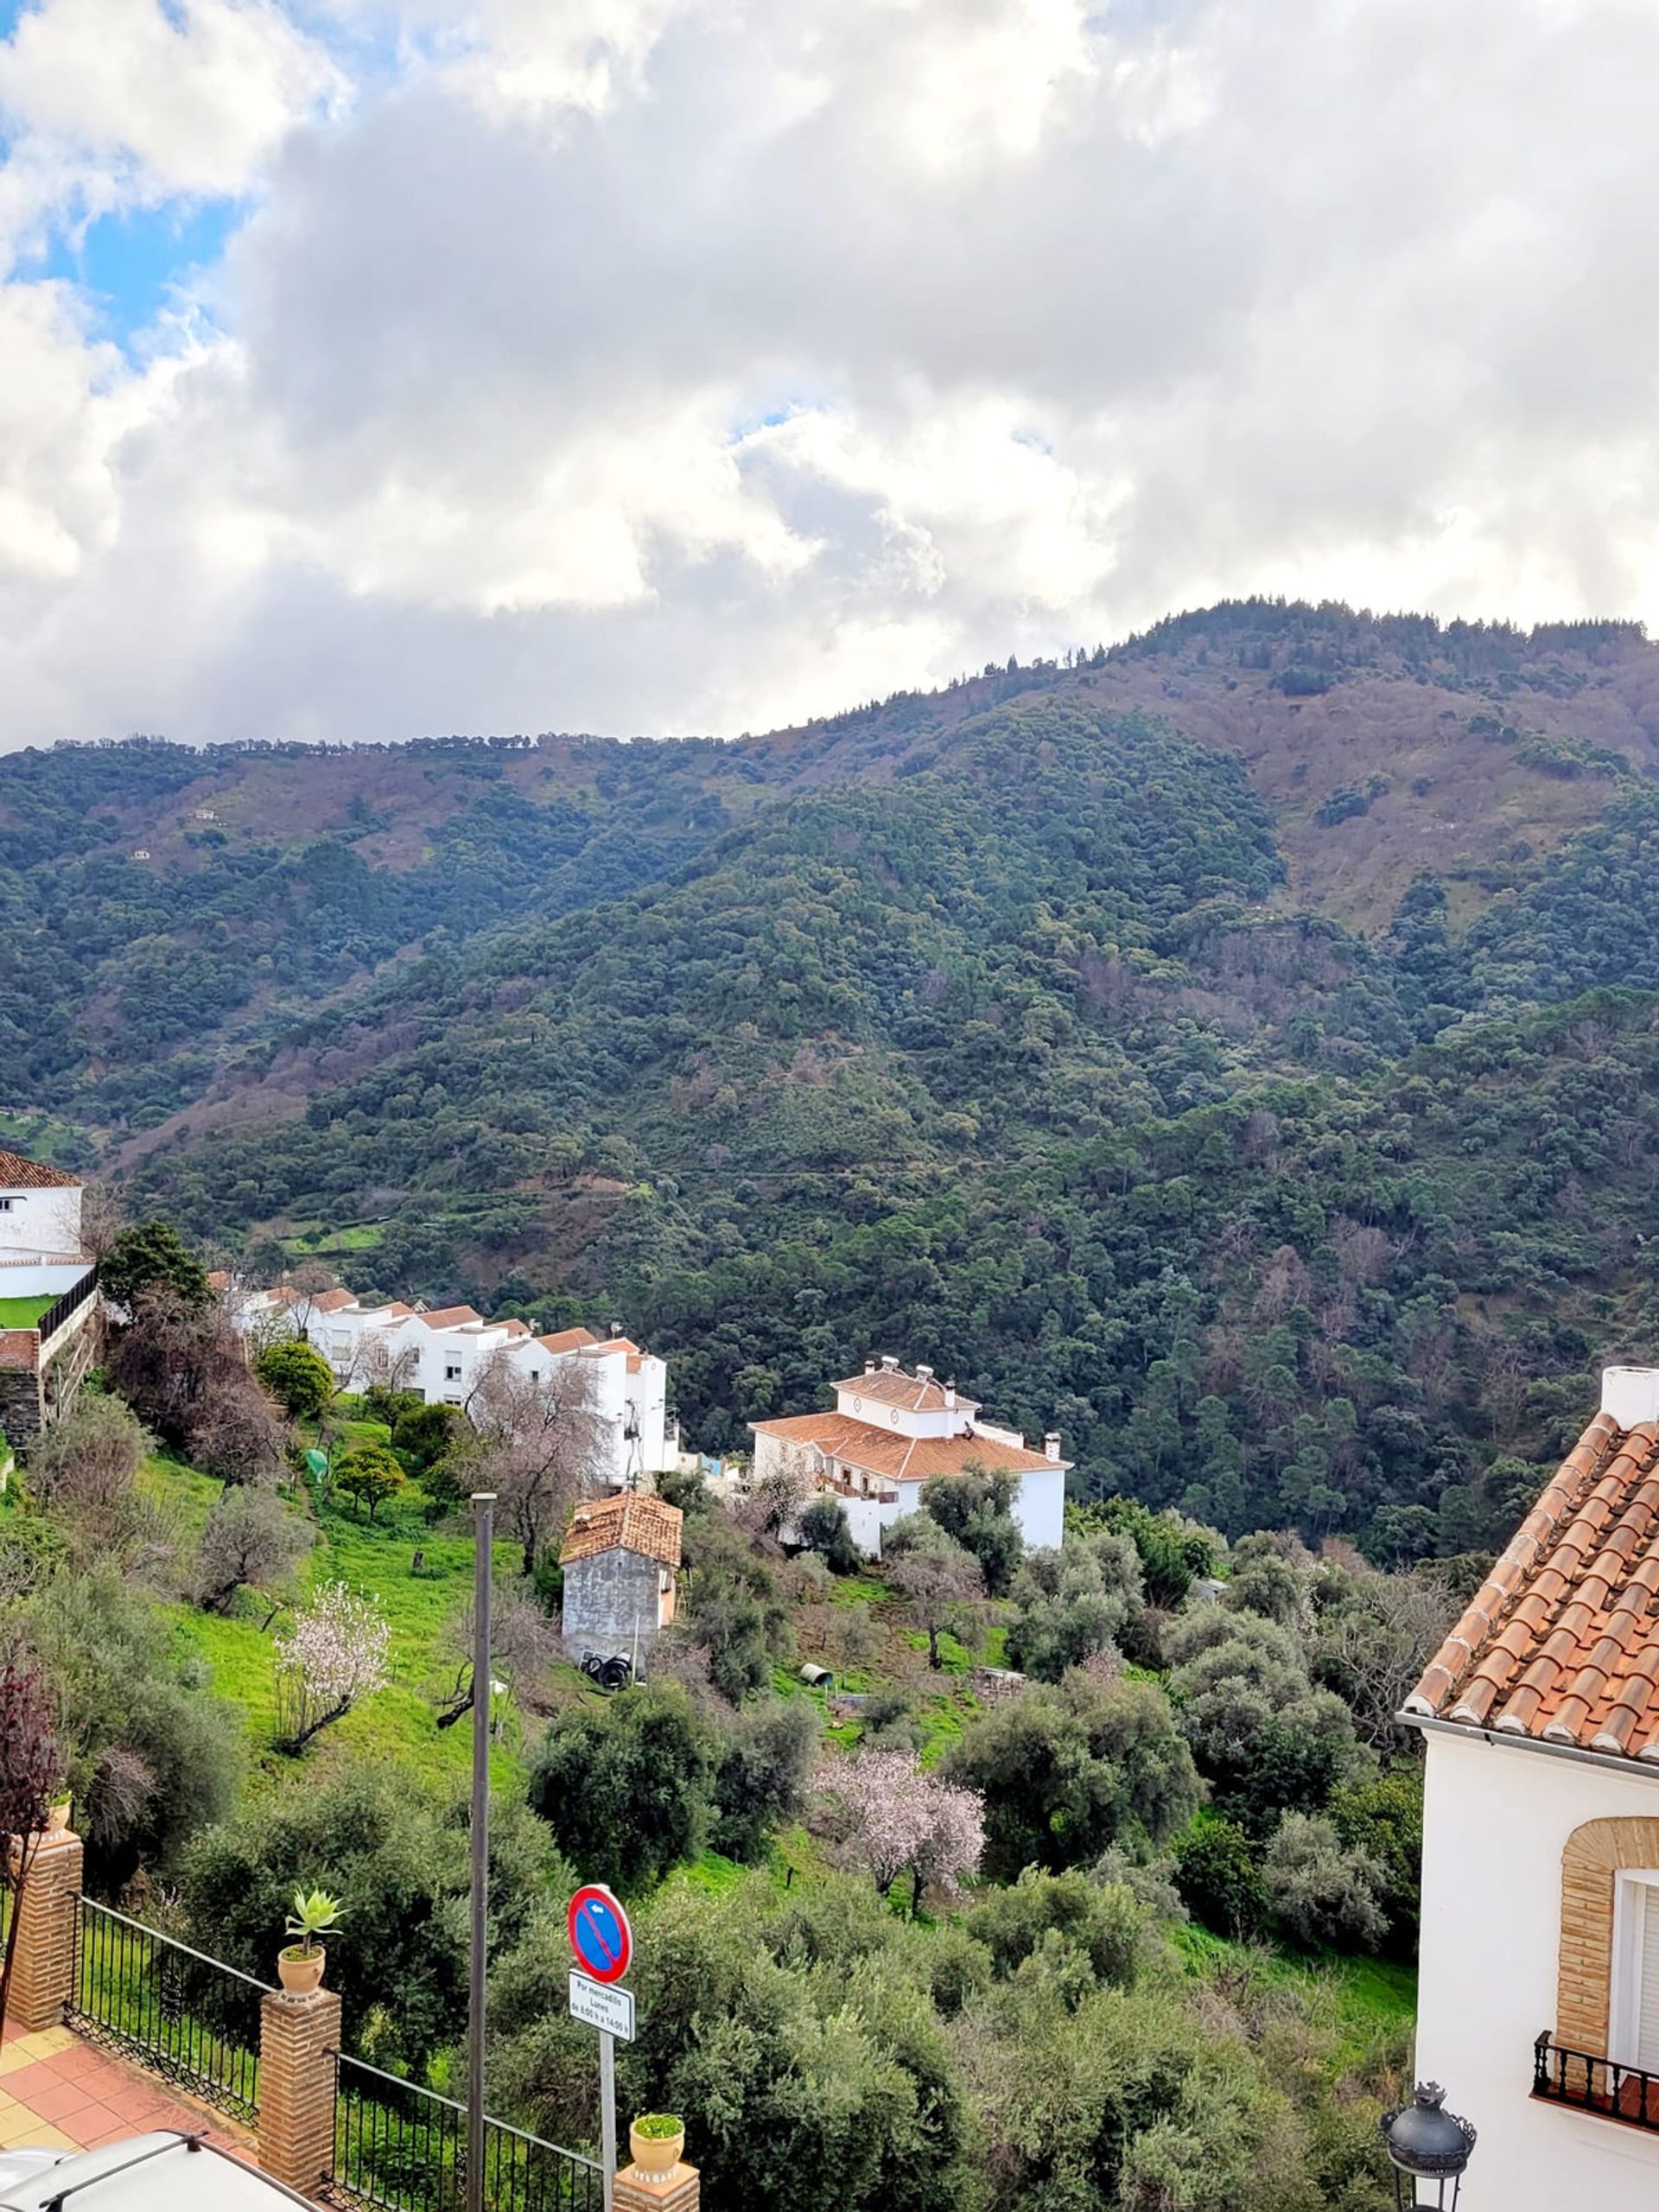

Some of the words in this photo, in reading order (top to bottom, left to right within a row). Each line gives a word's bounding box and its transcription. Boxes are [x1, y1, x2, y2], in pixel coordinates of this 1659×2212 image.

[577, 1980, 588, 1991] Por
[588, 1987, 622, 2006] mercadillo
[572, 2002, 579, 2012] de
[590, 1997, 608, 2013] Lunes
